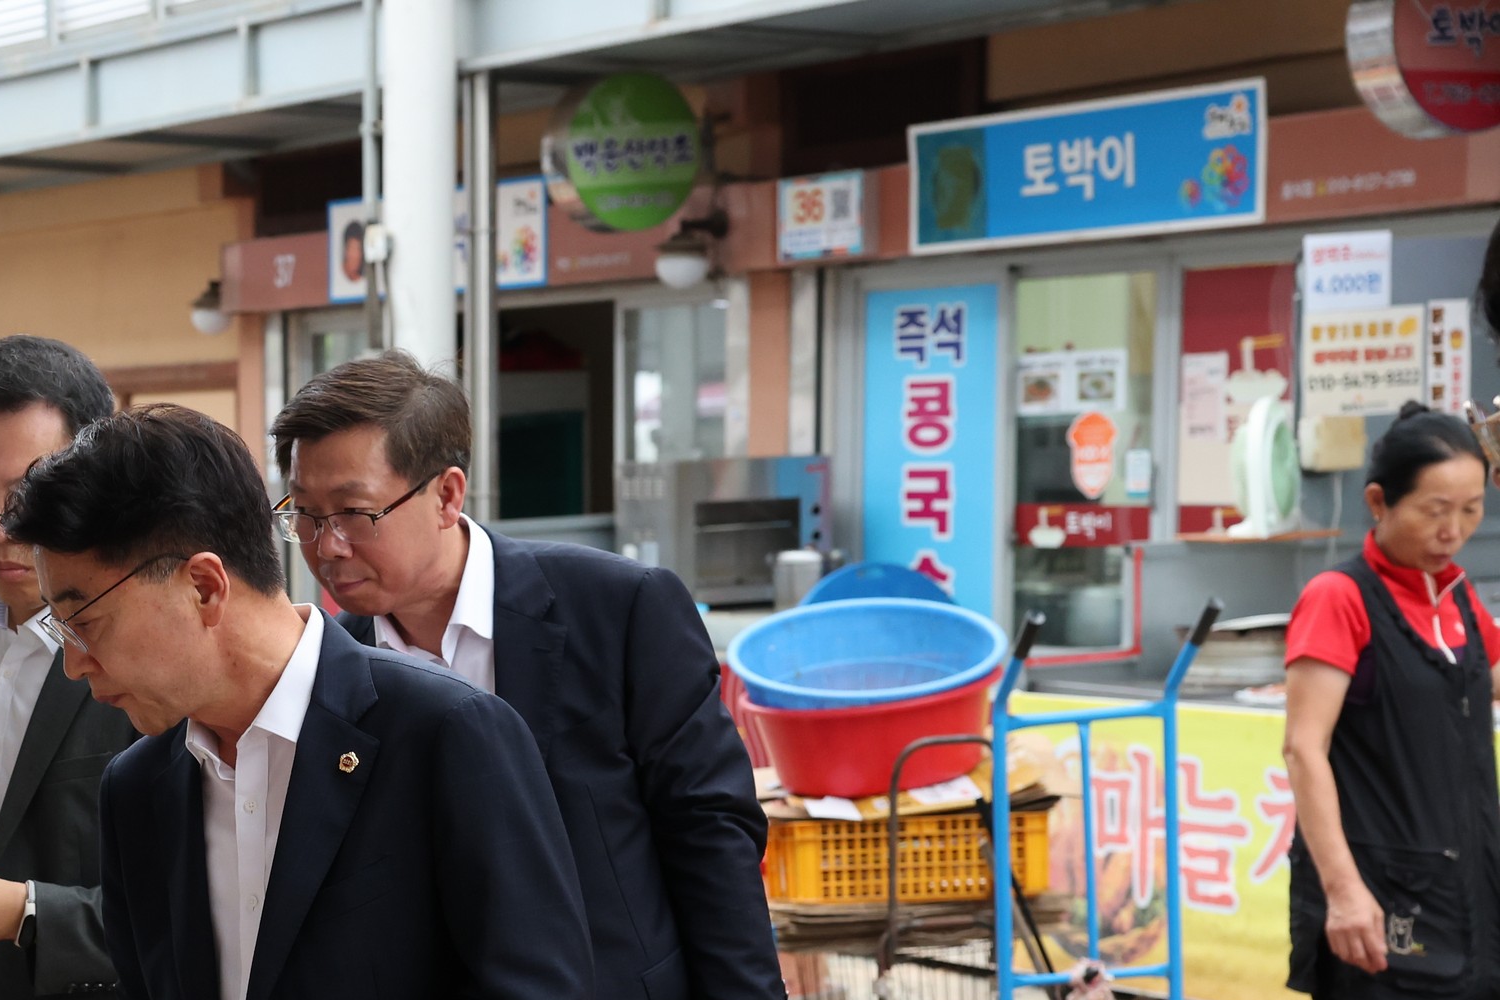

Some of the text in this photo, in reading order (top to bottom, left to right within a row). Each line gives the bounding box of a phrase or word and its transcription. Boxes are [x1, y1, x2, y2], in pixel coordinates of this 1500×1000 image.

[1020, 131, 1136, 201] 토박이
[793, 187, 825, 225] 36
[274, 253, 296, 289] 37
[896, 305, 964, 363] 즉석
